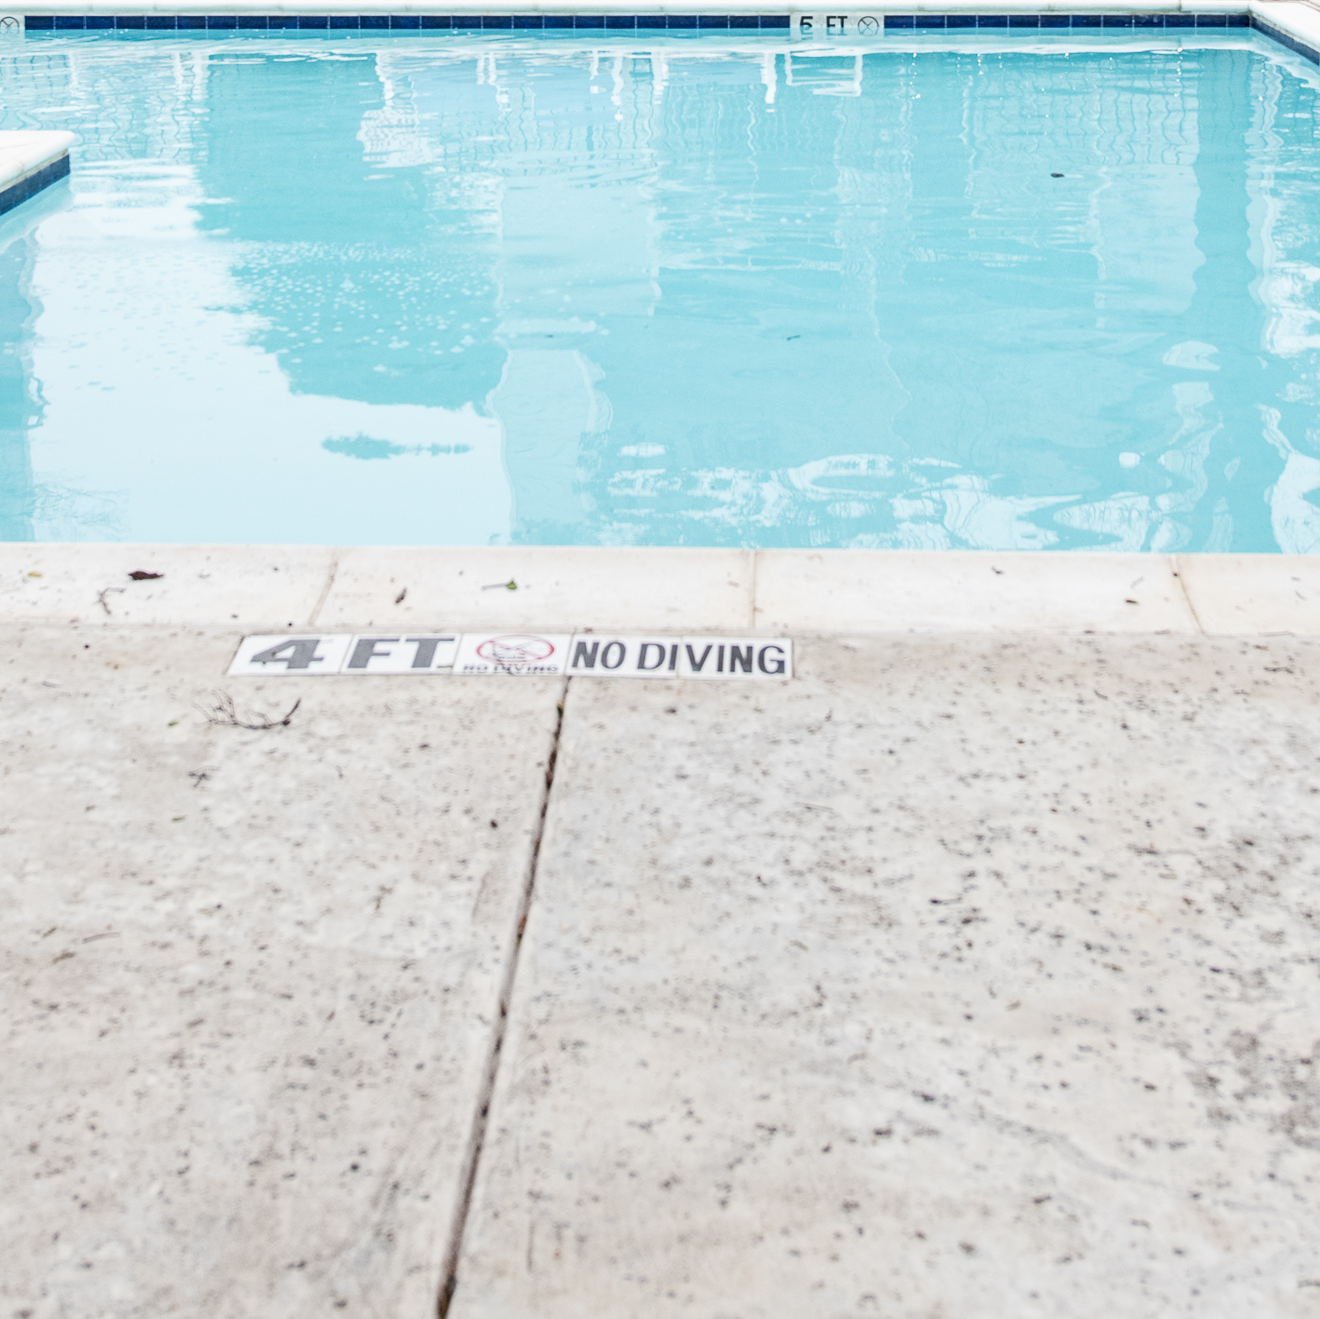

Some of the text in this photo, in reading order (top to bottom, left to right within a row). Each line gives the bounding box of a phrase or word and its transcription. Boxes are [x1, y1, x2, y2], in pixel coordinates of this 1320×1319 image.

[800, 15, 848, 28] 5 FT
[250, 638, 455, 669] 4 FT
[572, 641, 786, 674] NO DIVING
